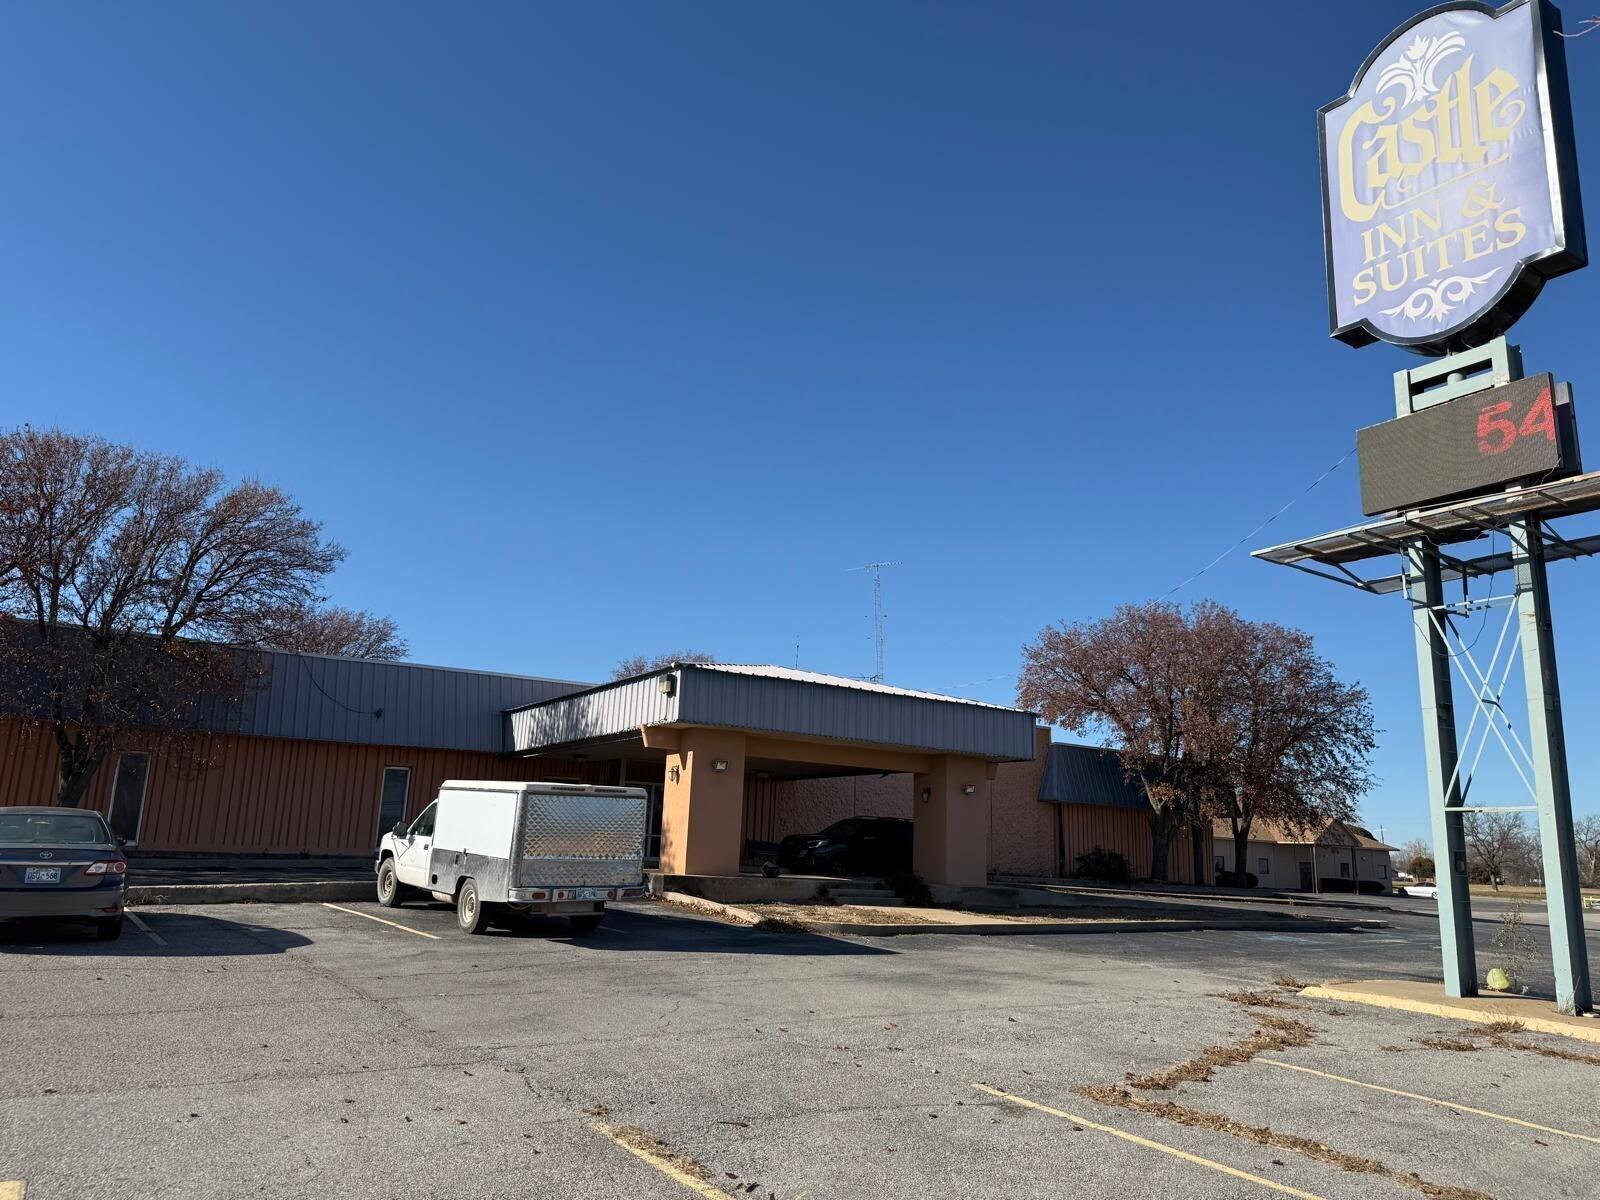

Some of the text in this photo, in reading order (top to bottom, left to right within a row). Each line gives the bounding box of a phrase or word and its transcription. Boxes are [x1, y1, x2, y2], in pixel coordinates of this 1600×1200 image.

[1338, 53, 1526, 222] Castle
[1352, 207, 1526, 306] SUITES
[1361, 181, 1505, 264] INN &
[1476, 387, 1556, 454] 54
